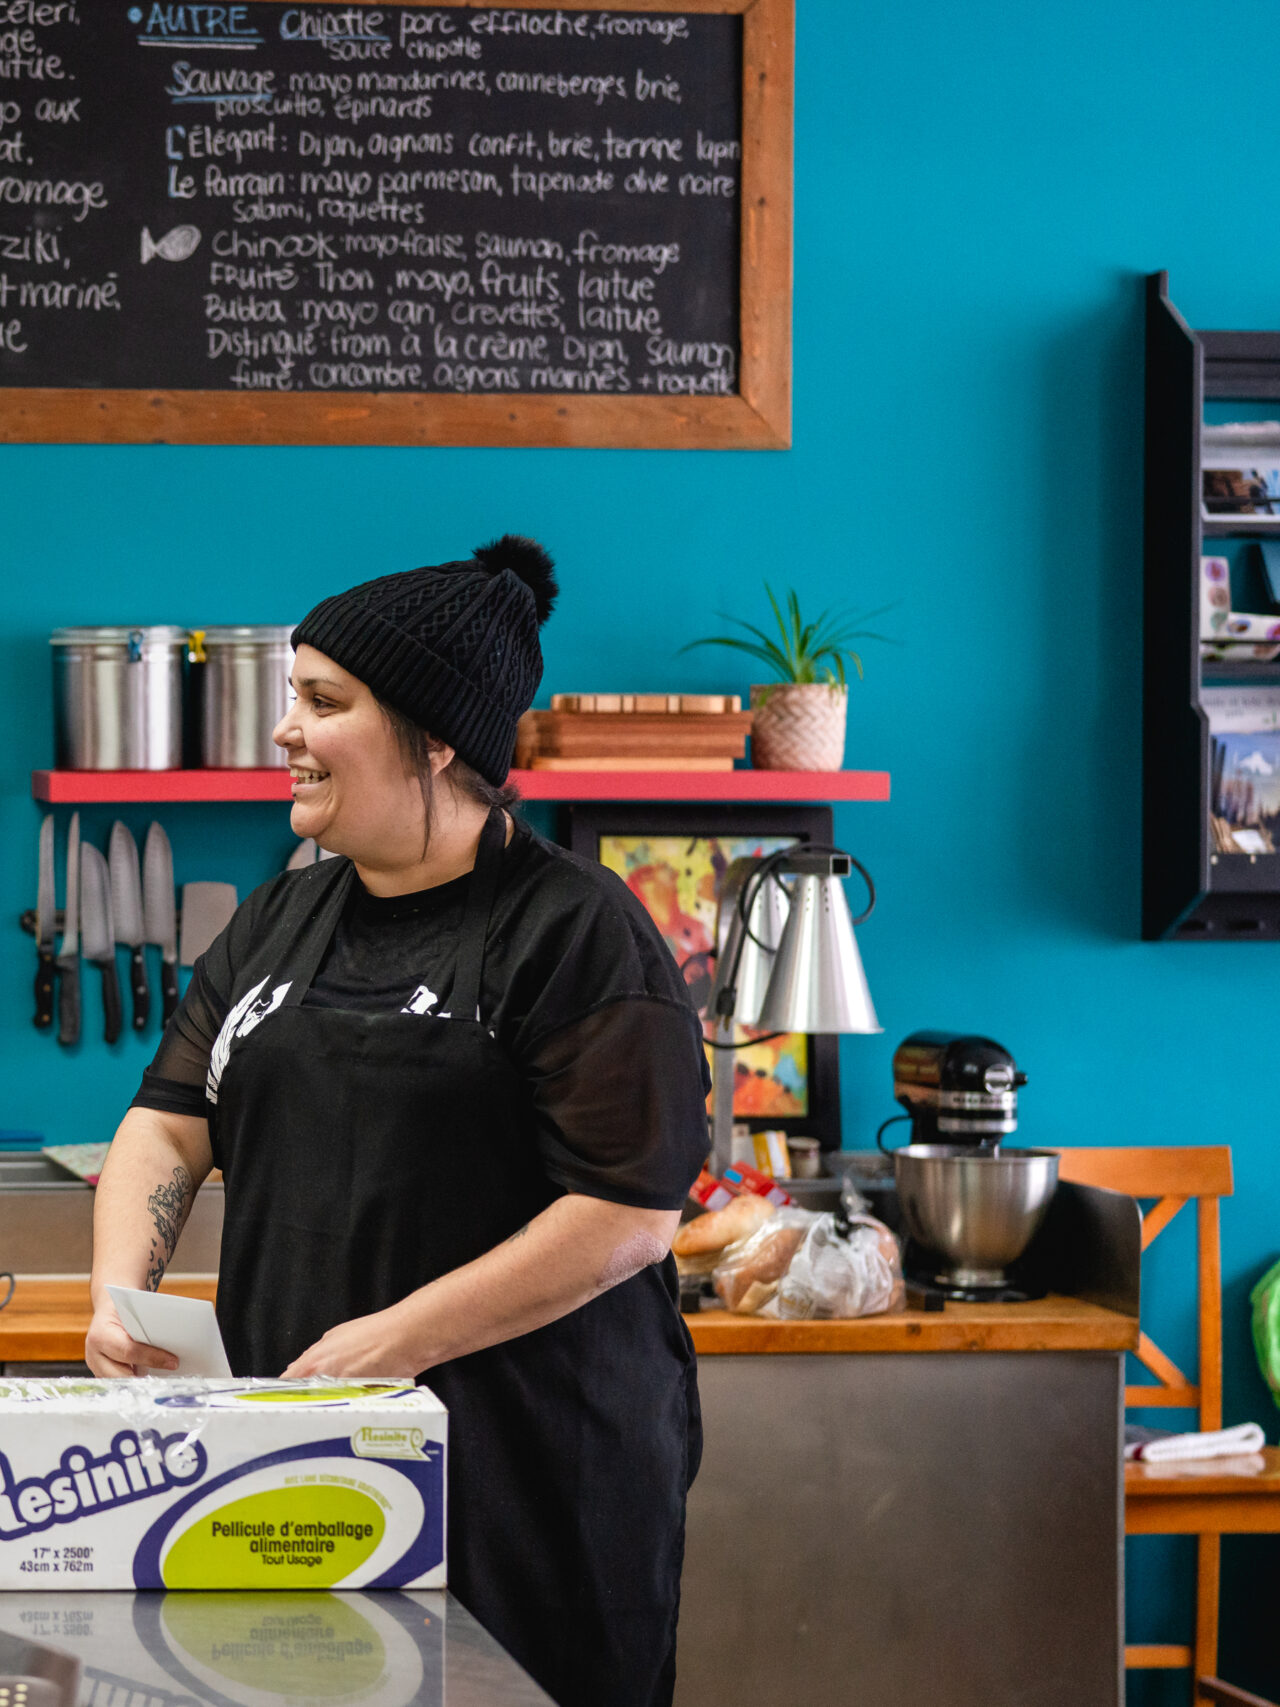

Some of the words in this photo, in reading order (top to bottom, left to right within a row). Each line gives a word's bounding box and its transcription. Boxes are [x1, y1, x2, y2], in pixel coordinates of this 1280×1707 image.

[146, 3, 258, 35] AUTRE
[280, 9, 384, 48] Chipotle
[400, 11, 456, 48] porc
[406, 36, 482, 63] chipotle
[166, 61, 276, 102] Sauvage
[289, 70, 352, 98] mayo
[496, 70, 626, 106] canneberges
[34, 97, 82, 124] aux
[334, 95, 433, 125] épinards
[368, 131, 454, 163] oignons
[601, 126, 684, 163] terrine
[168, 165, 197, 199] Le
[300, 170, 371, 199] mayo
[510, 164, 614, 202] tapenade
[623, 166, 670, 195] olive
[678, 171, 736, 199] noire
[318, 196, 424, 226] roquettes
[212, 230, 338, 259] Chinook
[345, 233, 399, 260] mayo
[572, 229, 680, 275] fromage
[578, 268, 656, 302] laitue
[204, 293, 287, 322] Bubba
[302, 299, 379, 332] mayo
[577, 301, 664, 337] laitue
[330, 324, 392, 358] from
[433, 322, 458, 360] la
[212, 1521, 275, 1537] Pellicule
[280, 1521, 374, 1540] d'emballage
[250, 1538, 335, 1553] alimentaire
[20, 1561, 50, 1572] 43cm
[53, 1564, 60, 1572] x
[63, 1561, 94, 1573] 762m
[262, 1554, 284, 1565] Tout
[287, 1554, 322, 1567] Usage
